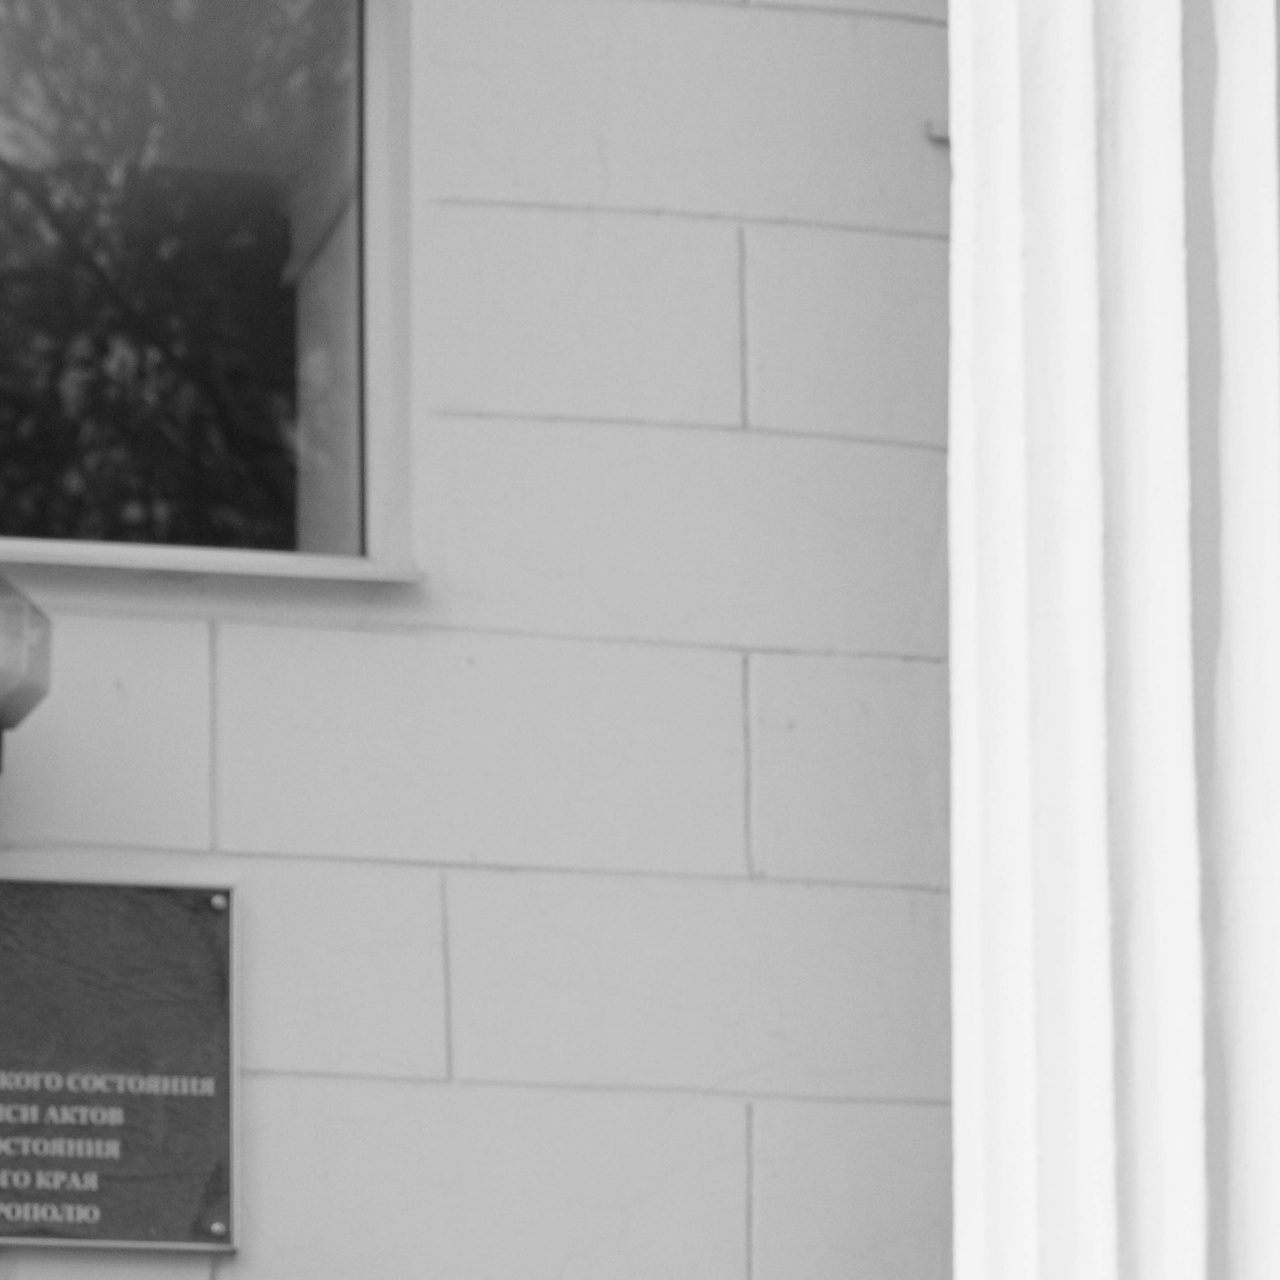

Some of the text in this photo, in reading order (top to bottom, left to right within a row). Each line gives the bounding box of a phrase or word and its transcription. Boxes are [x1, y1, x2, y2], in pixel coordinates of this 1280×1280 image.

[66, 1072, 216, 1096] СОСТОЯНИЯ
[43, 1106, 125, 1126] АКТОВ
[35, 1171, 100, 1191] КРАЯ
